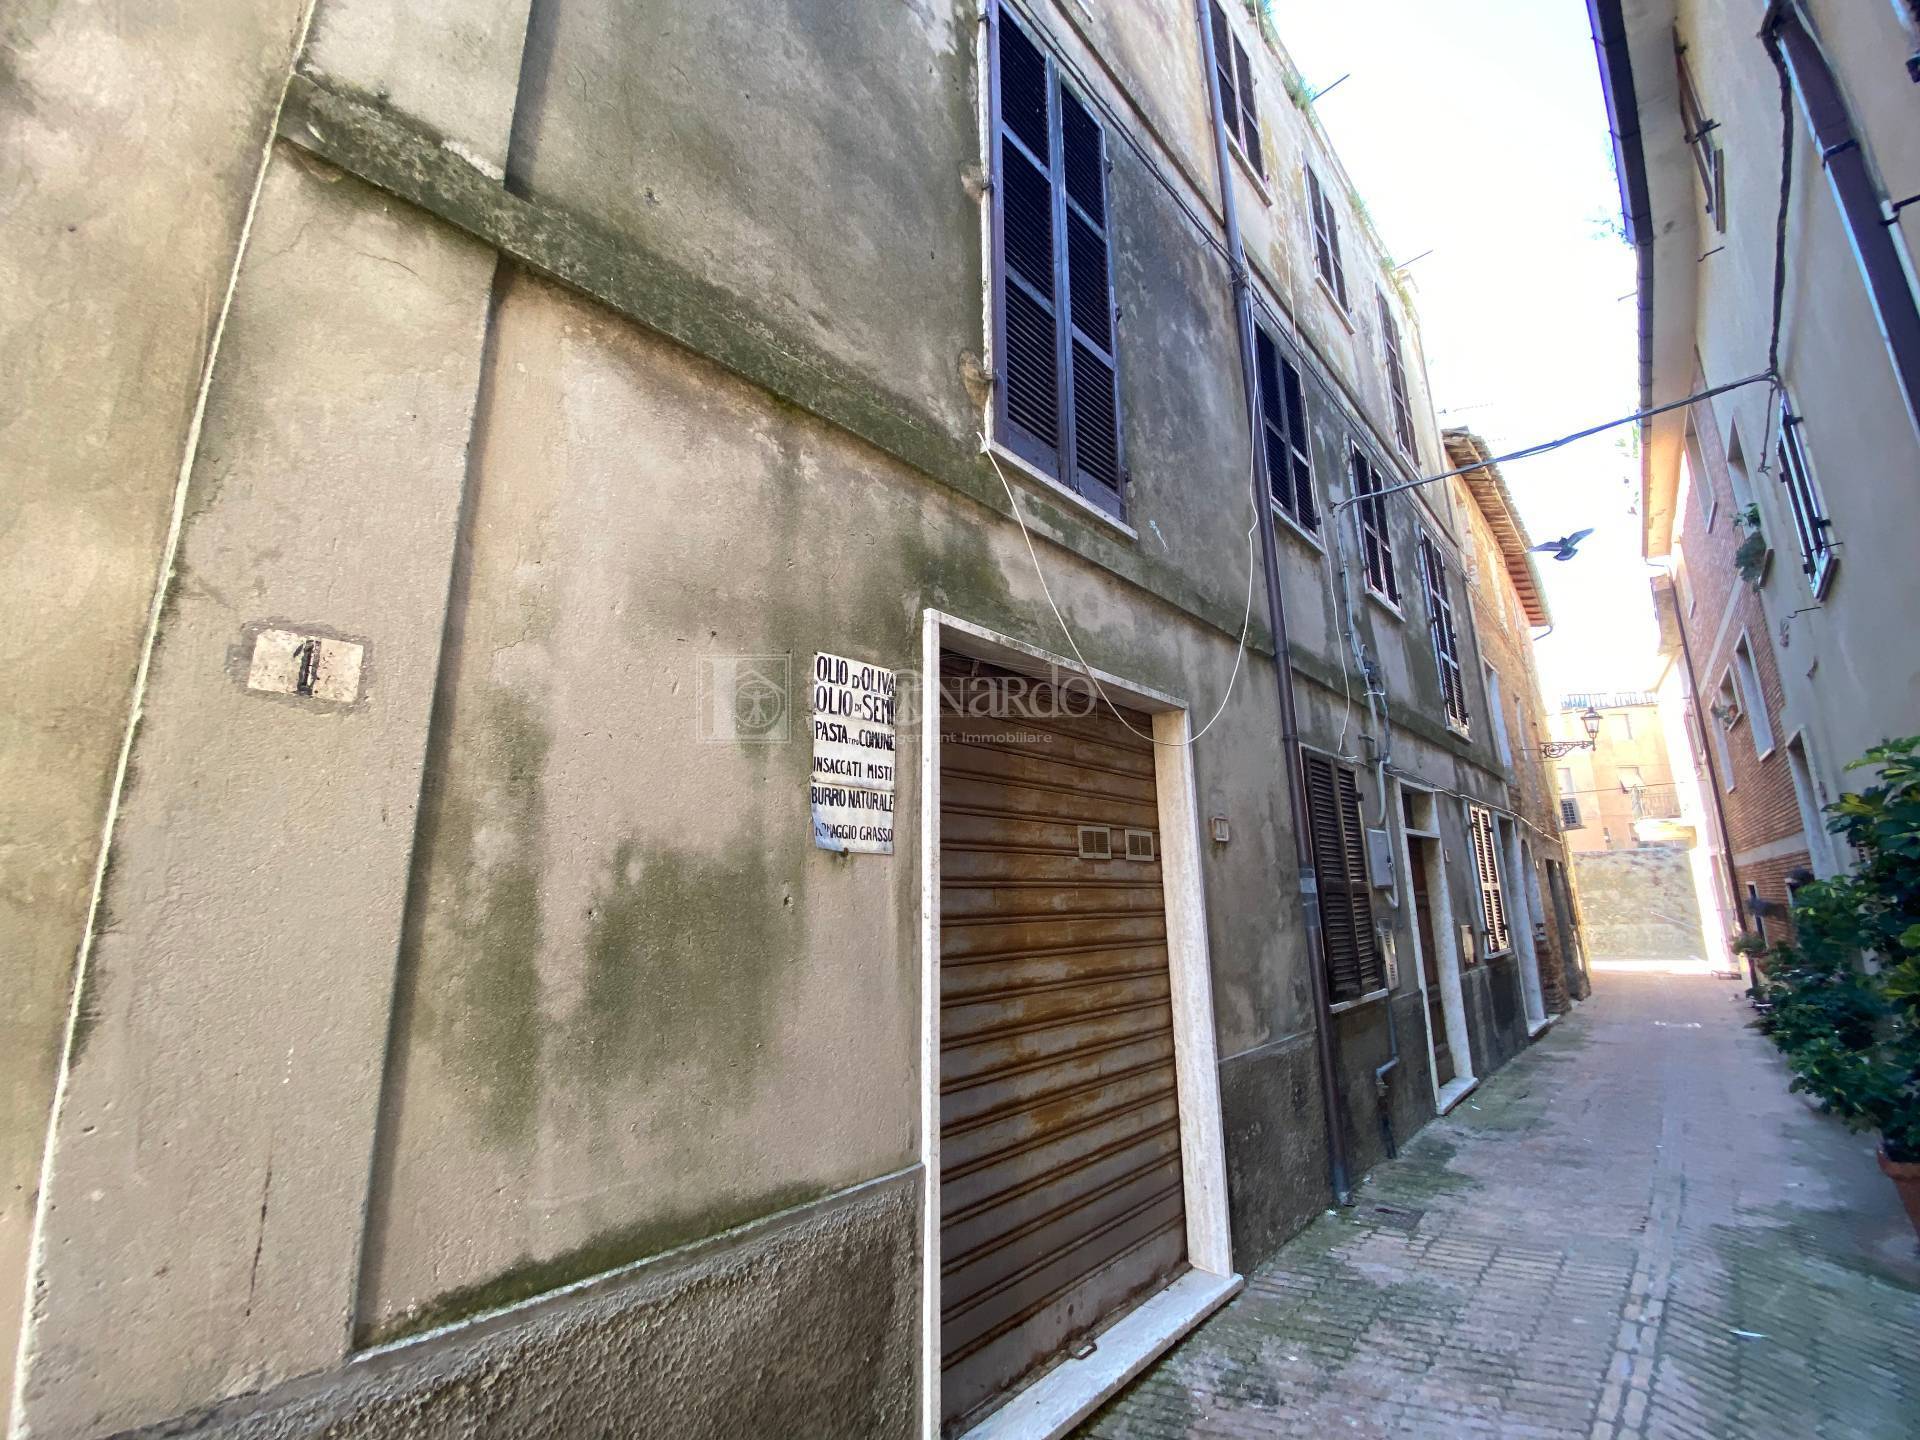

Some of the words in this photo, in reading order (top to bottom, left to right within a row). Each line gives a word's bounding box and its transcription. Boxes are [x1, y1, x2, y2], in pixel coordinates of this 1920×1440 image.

[816, 655, 849, 686] OLIO
[816, 685, 853, 717] OLIO
[862, 694, 895, 726] SEMI
[815, 721, 848, 744] PASTA
[859, 729, 895, 751] COMUNE
[813, 756, 862, 777] INSACCATI
[867, 763, 893, 781] MISTI
[811, 786, 845, 807] BURRO
[848, 789, 894, 813] NATURALE
[859, 825, 893, 842] GRASSO
